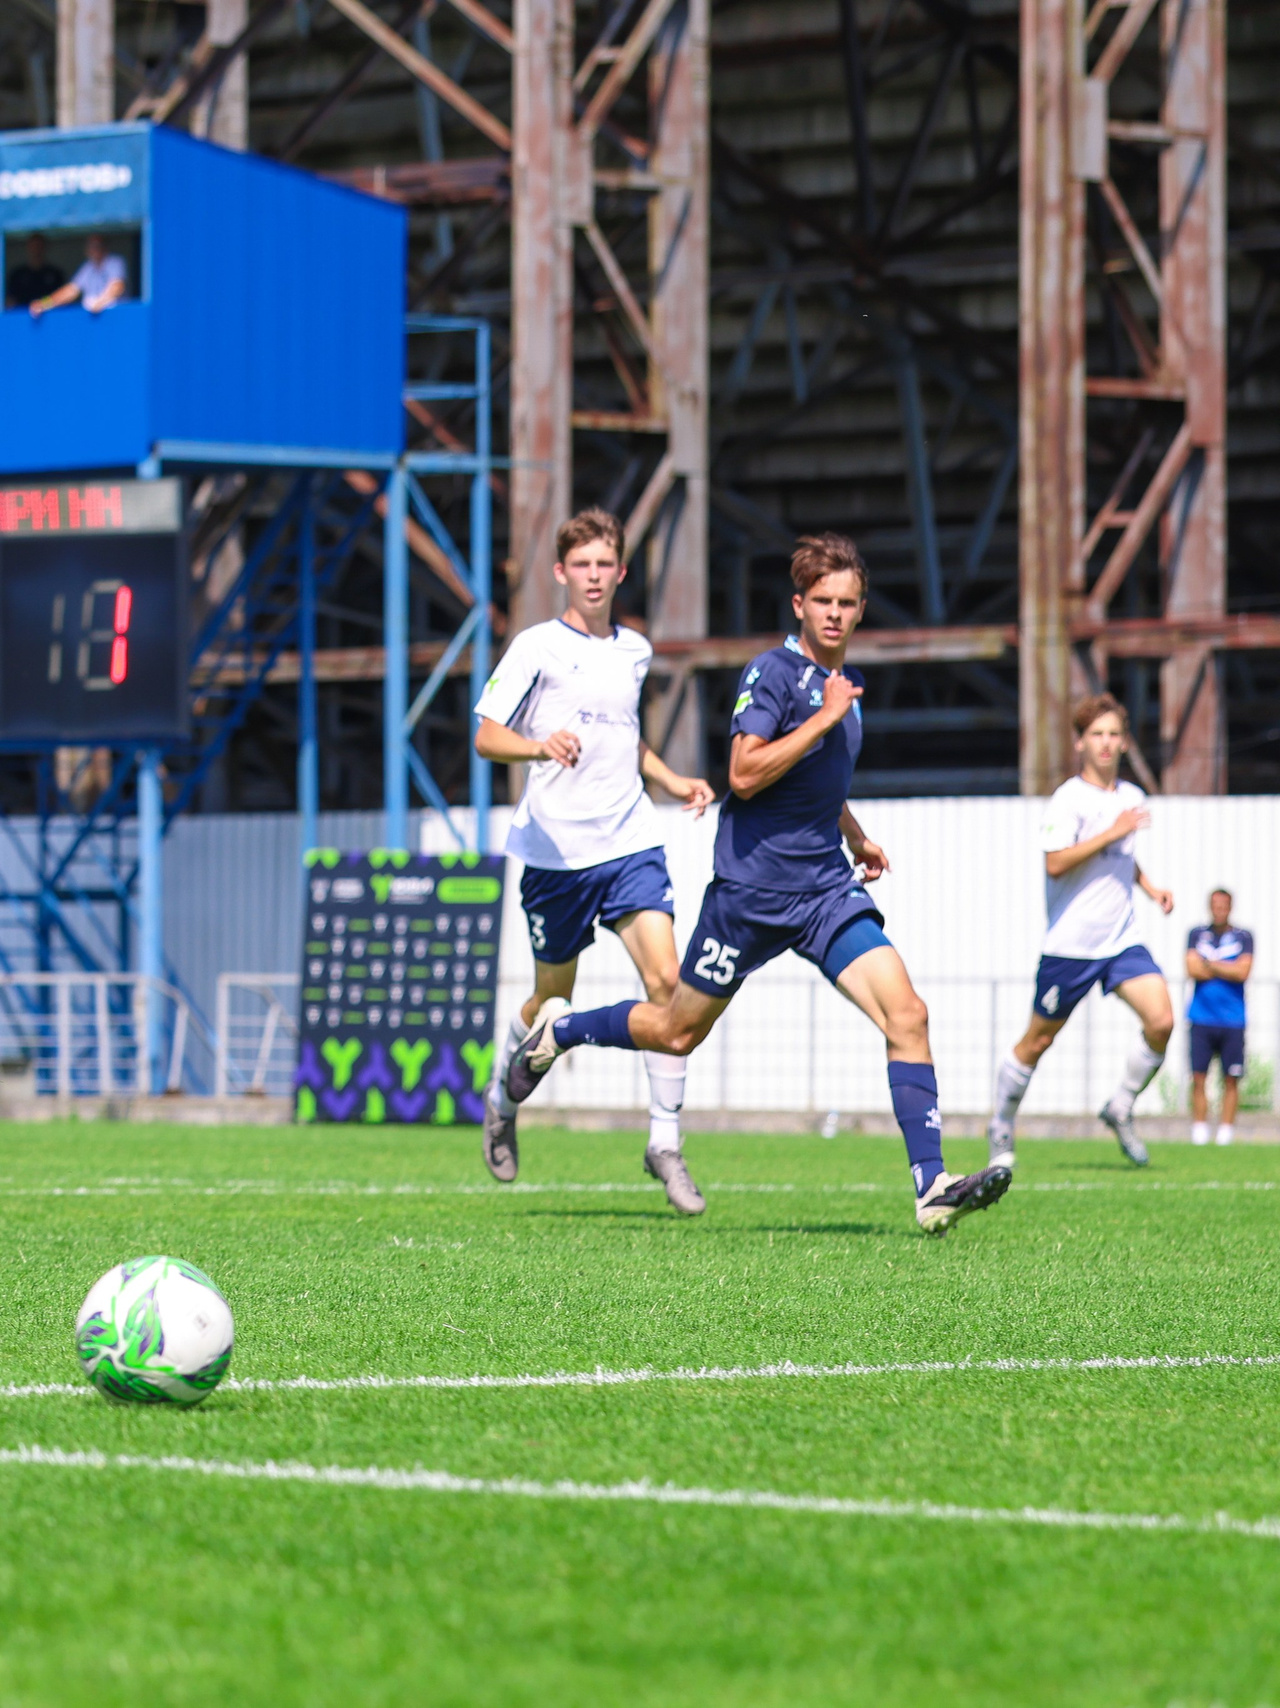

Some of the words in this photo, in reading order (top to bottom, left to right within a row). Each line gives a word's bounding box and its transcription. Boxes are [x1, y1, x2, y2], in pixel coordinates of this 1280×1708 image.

[68, 486, 123, 529] НН
[694, 937, 741, 986] 25
[1041, 984, 1060, 1015] 4
